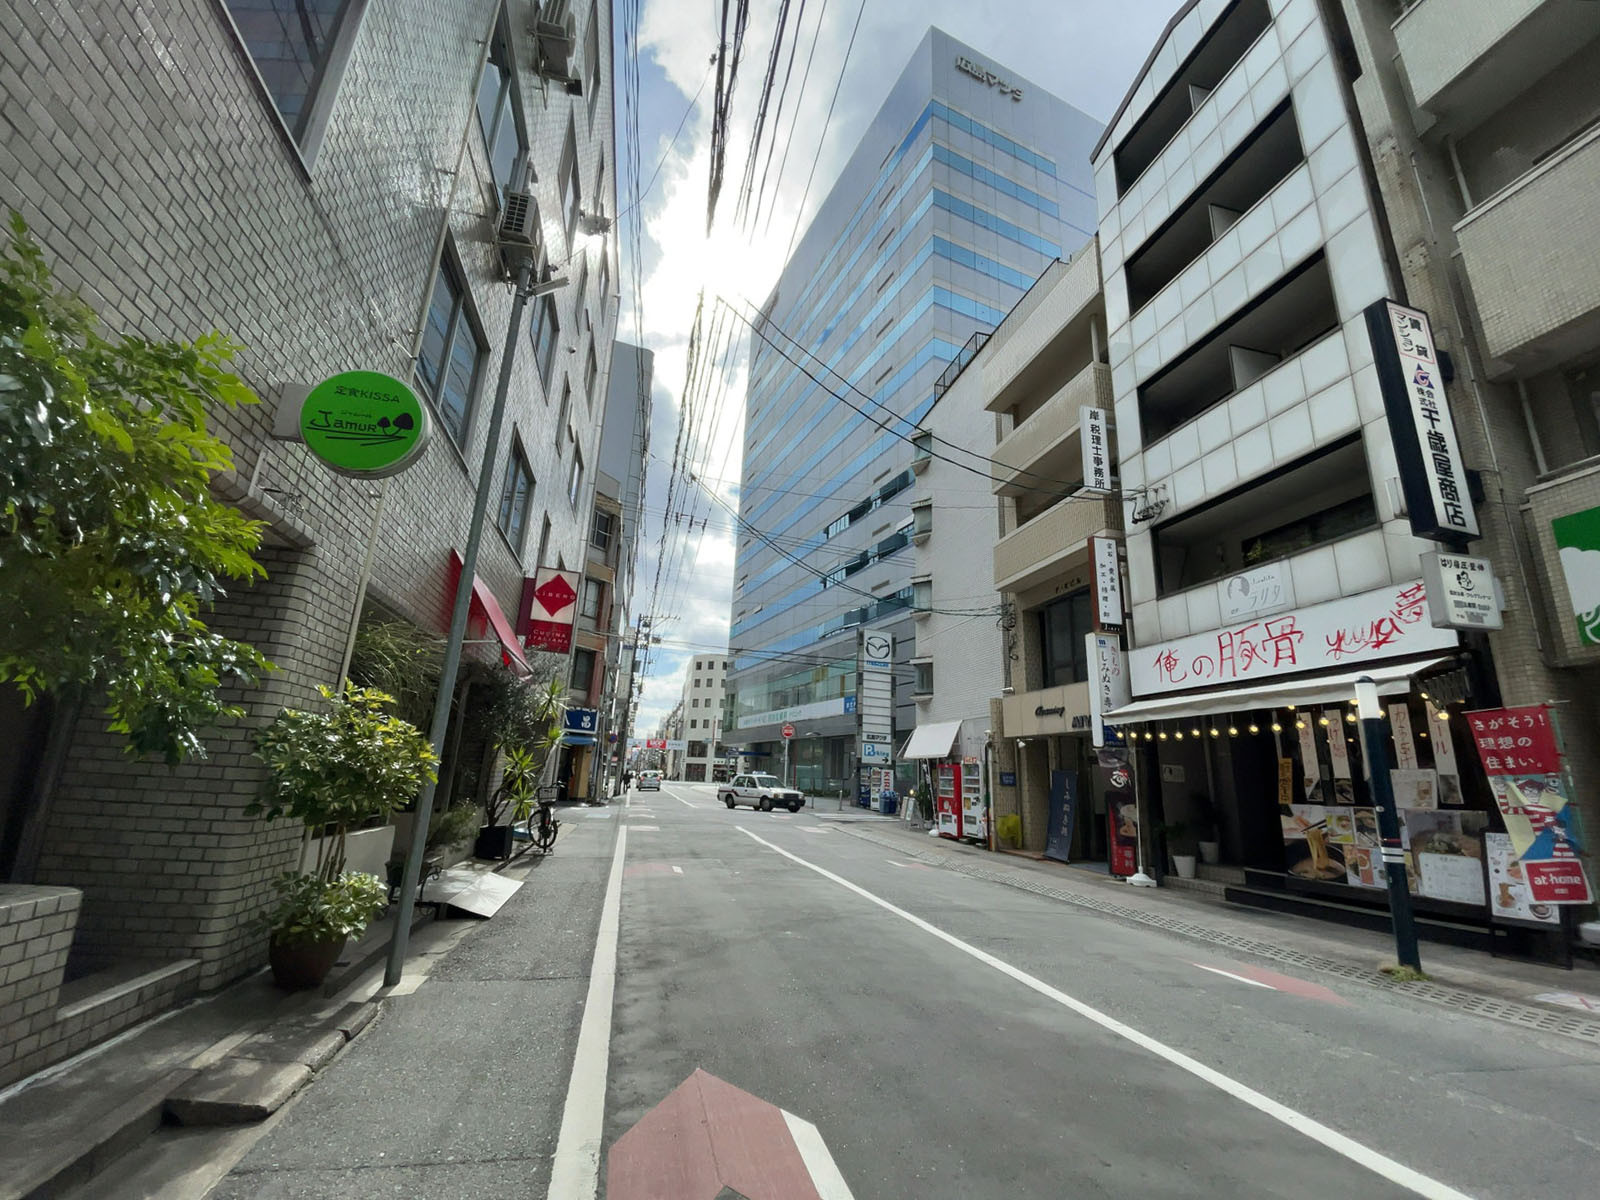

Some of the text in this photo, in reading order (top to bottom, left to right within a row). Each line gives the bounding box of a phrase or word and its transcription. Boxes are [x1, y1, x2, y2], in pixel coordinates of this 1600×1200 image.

[1152, 615, 1305, 684] 俺の豚骨
[1479, 736, 1532, 750] 理想の
[1534, 874, 1581, 885] at home
